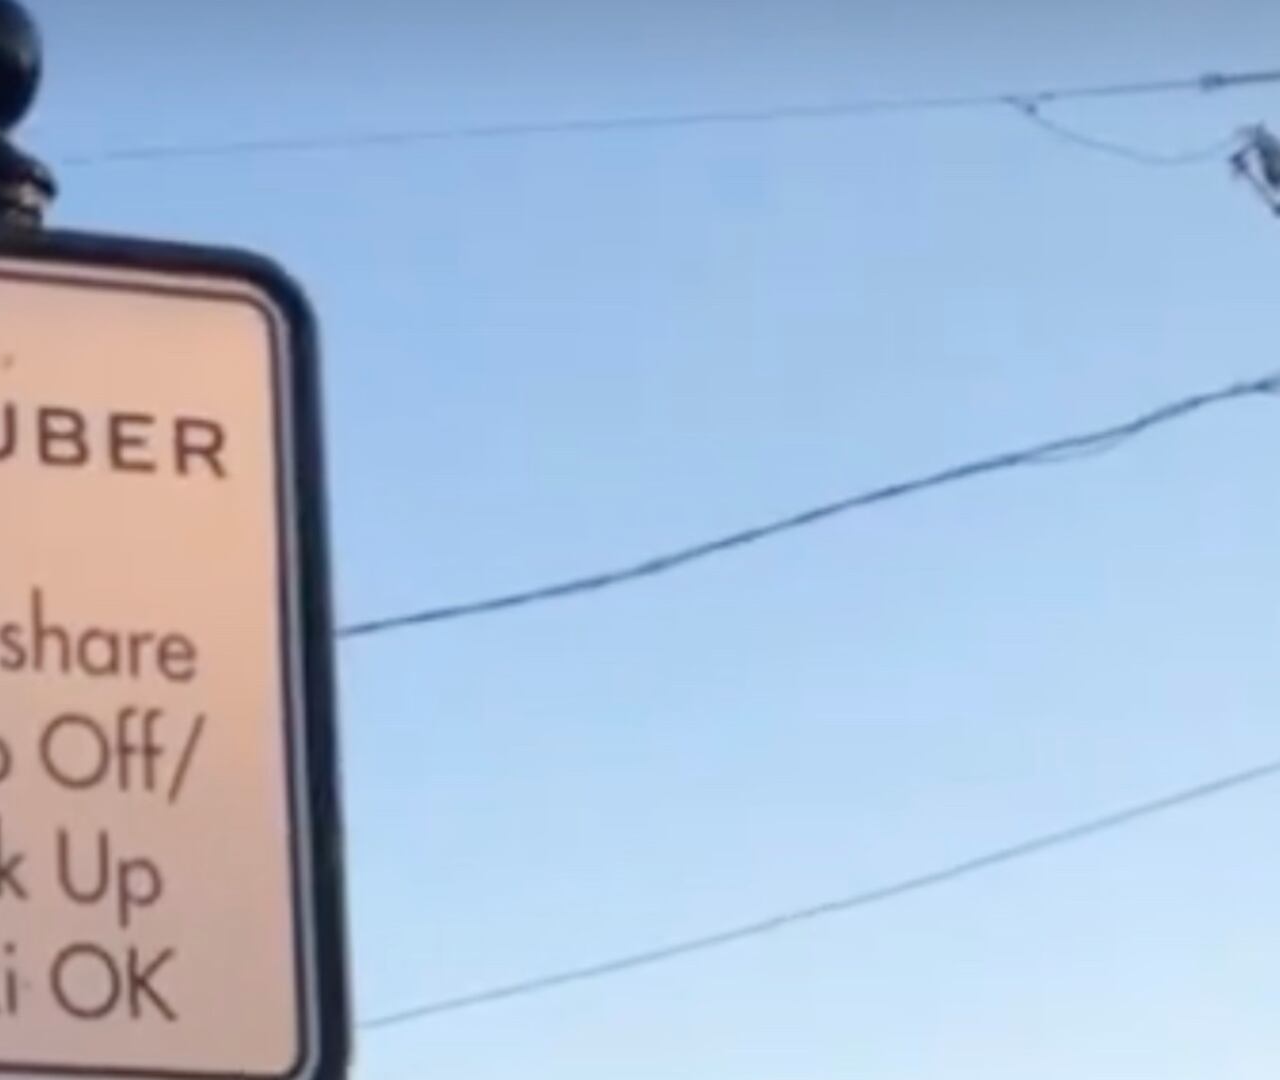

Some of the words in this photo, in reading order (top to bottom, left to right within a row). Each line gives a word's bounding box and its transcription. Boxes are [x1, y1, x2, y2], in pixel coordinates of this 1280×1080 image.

[39, 706, 205, 804] Off/
[57, 829, 163, 929] Up
[49, 942, 177, 1021] OK
